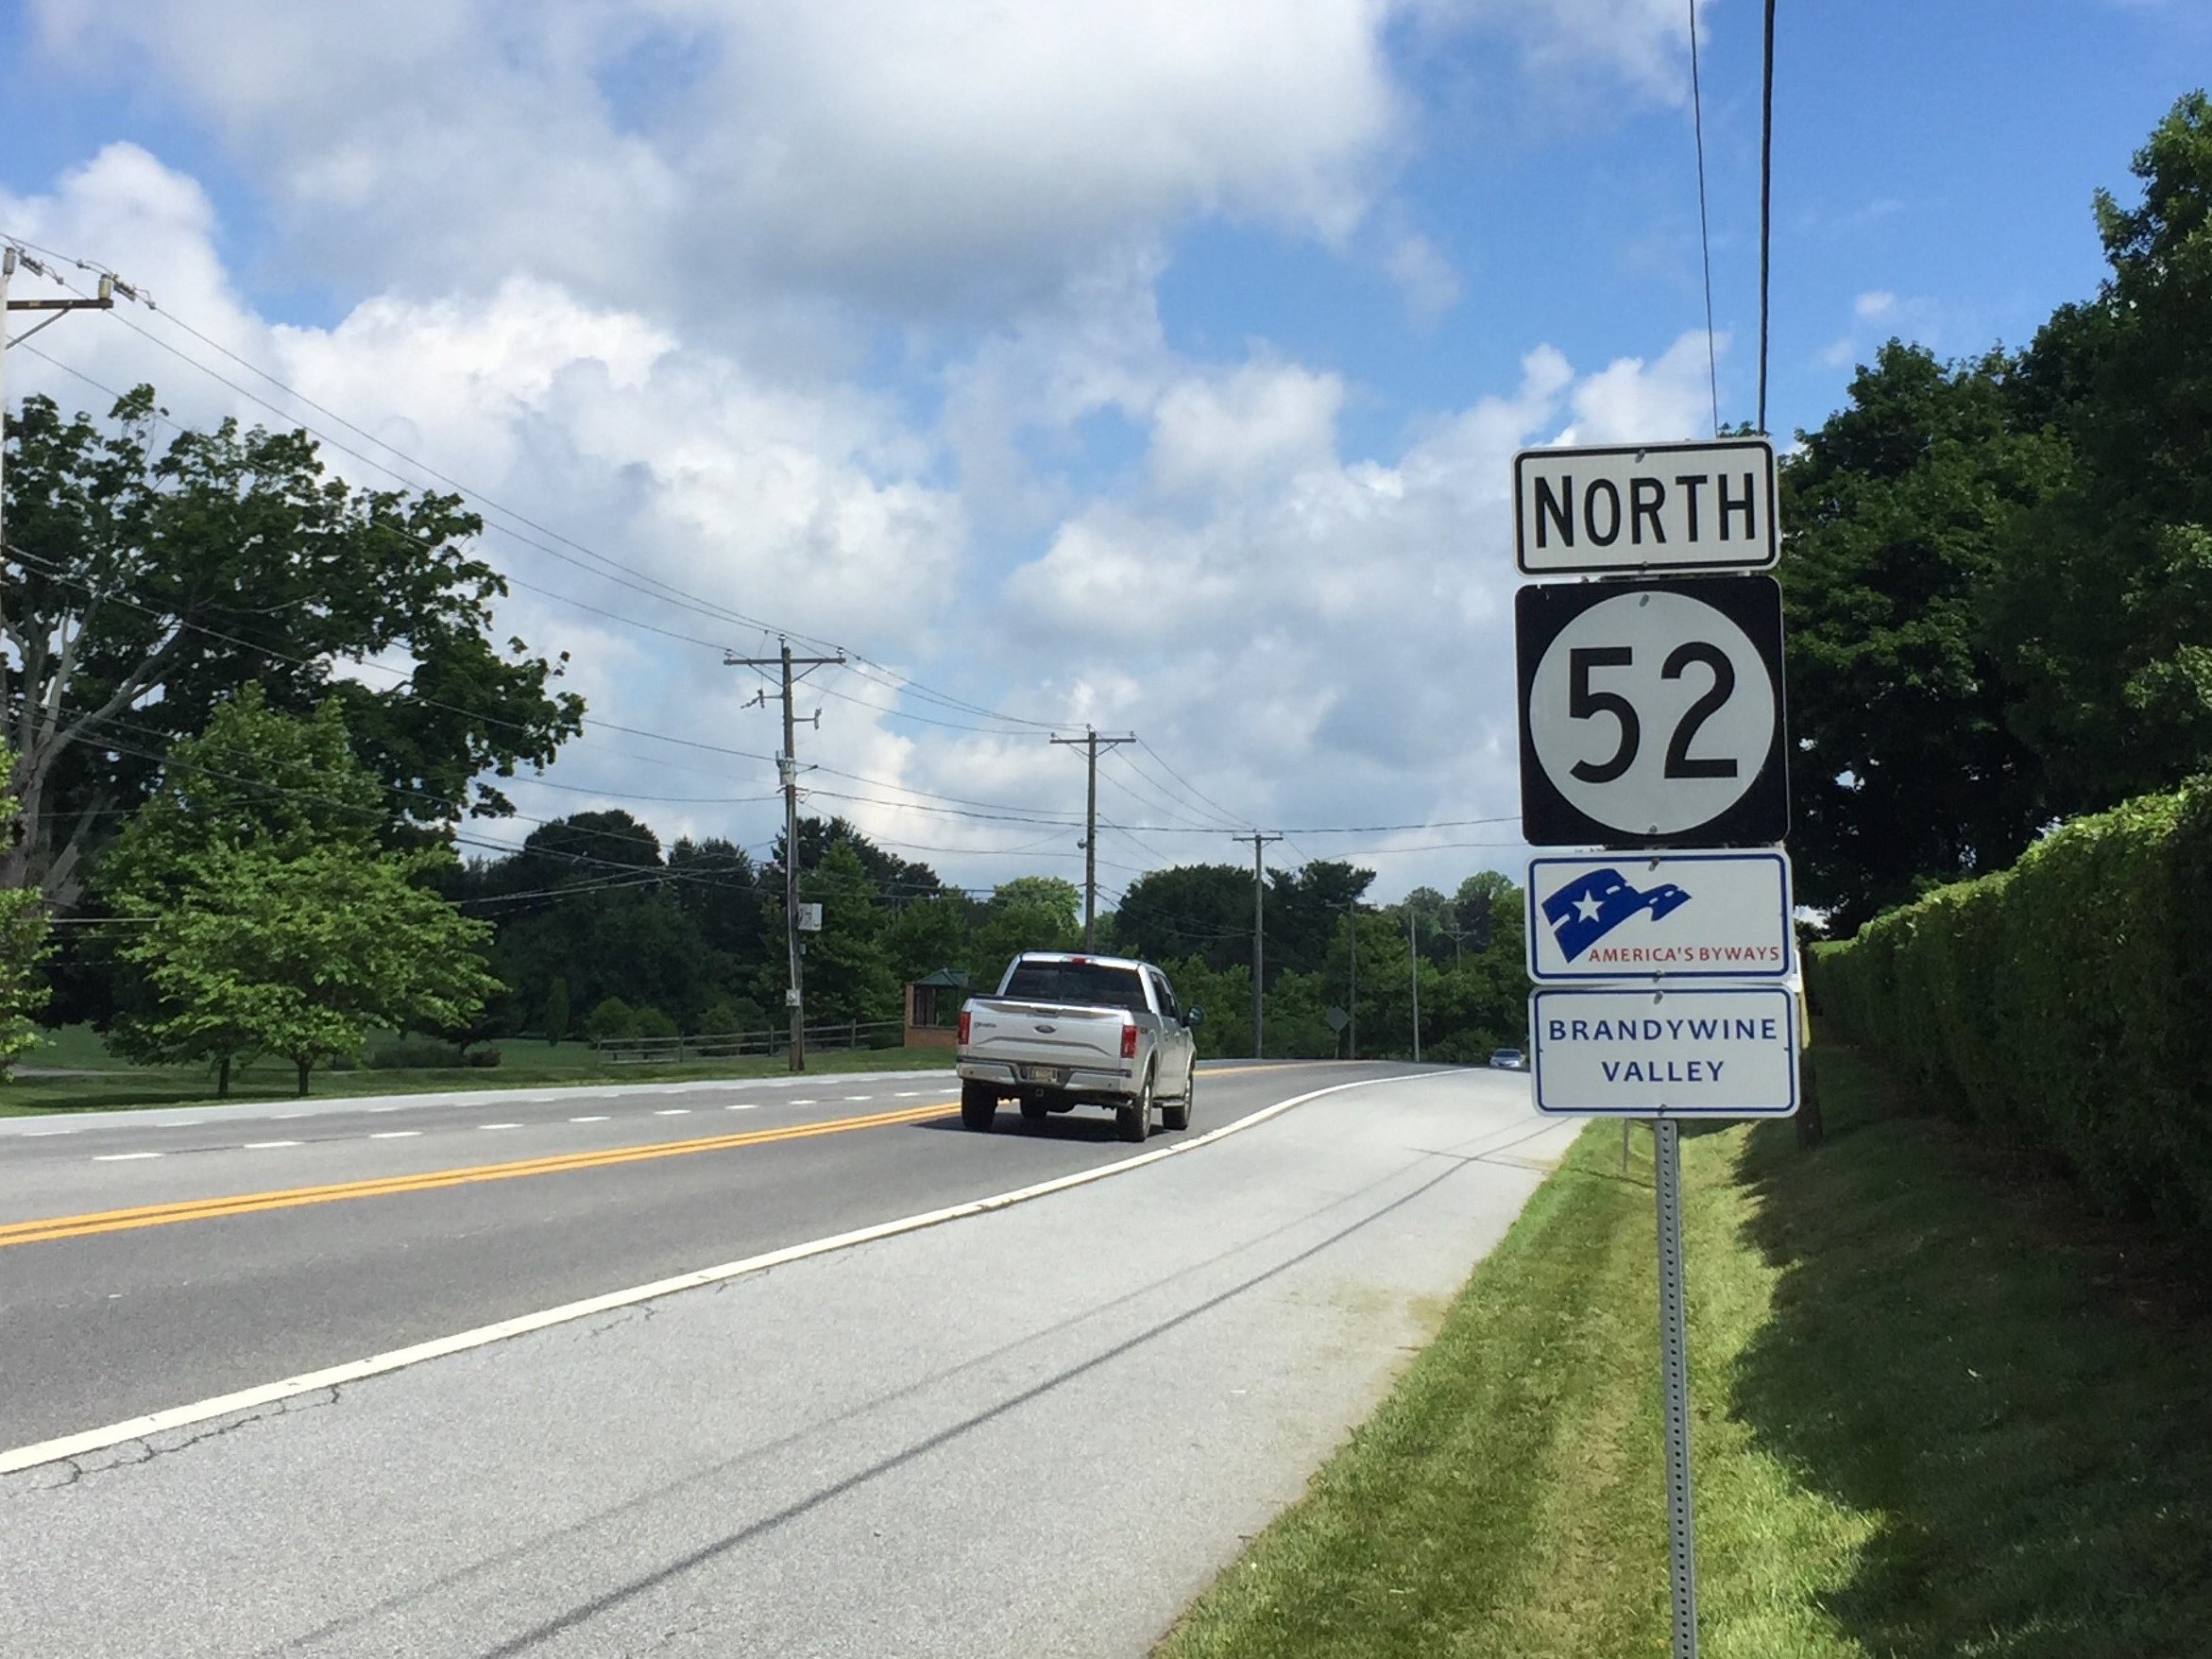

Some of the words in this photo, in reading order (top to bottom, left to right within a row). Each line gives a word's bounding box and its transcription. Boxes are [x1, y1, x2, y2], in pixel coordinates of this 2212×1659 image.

[1535, 473, 1755, 548] NORTH
[1569, 641, 1738, 783] 52
[1589, 947, 1693, 962] AMERICA'S
[1700, 947, 1779, 961] BYWAYS
[1549, 1019, 1777, 1040] BRANDYWINE
[1602, 1061, 1725, 1082] VALLEY
